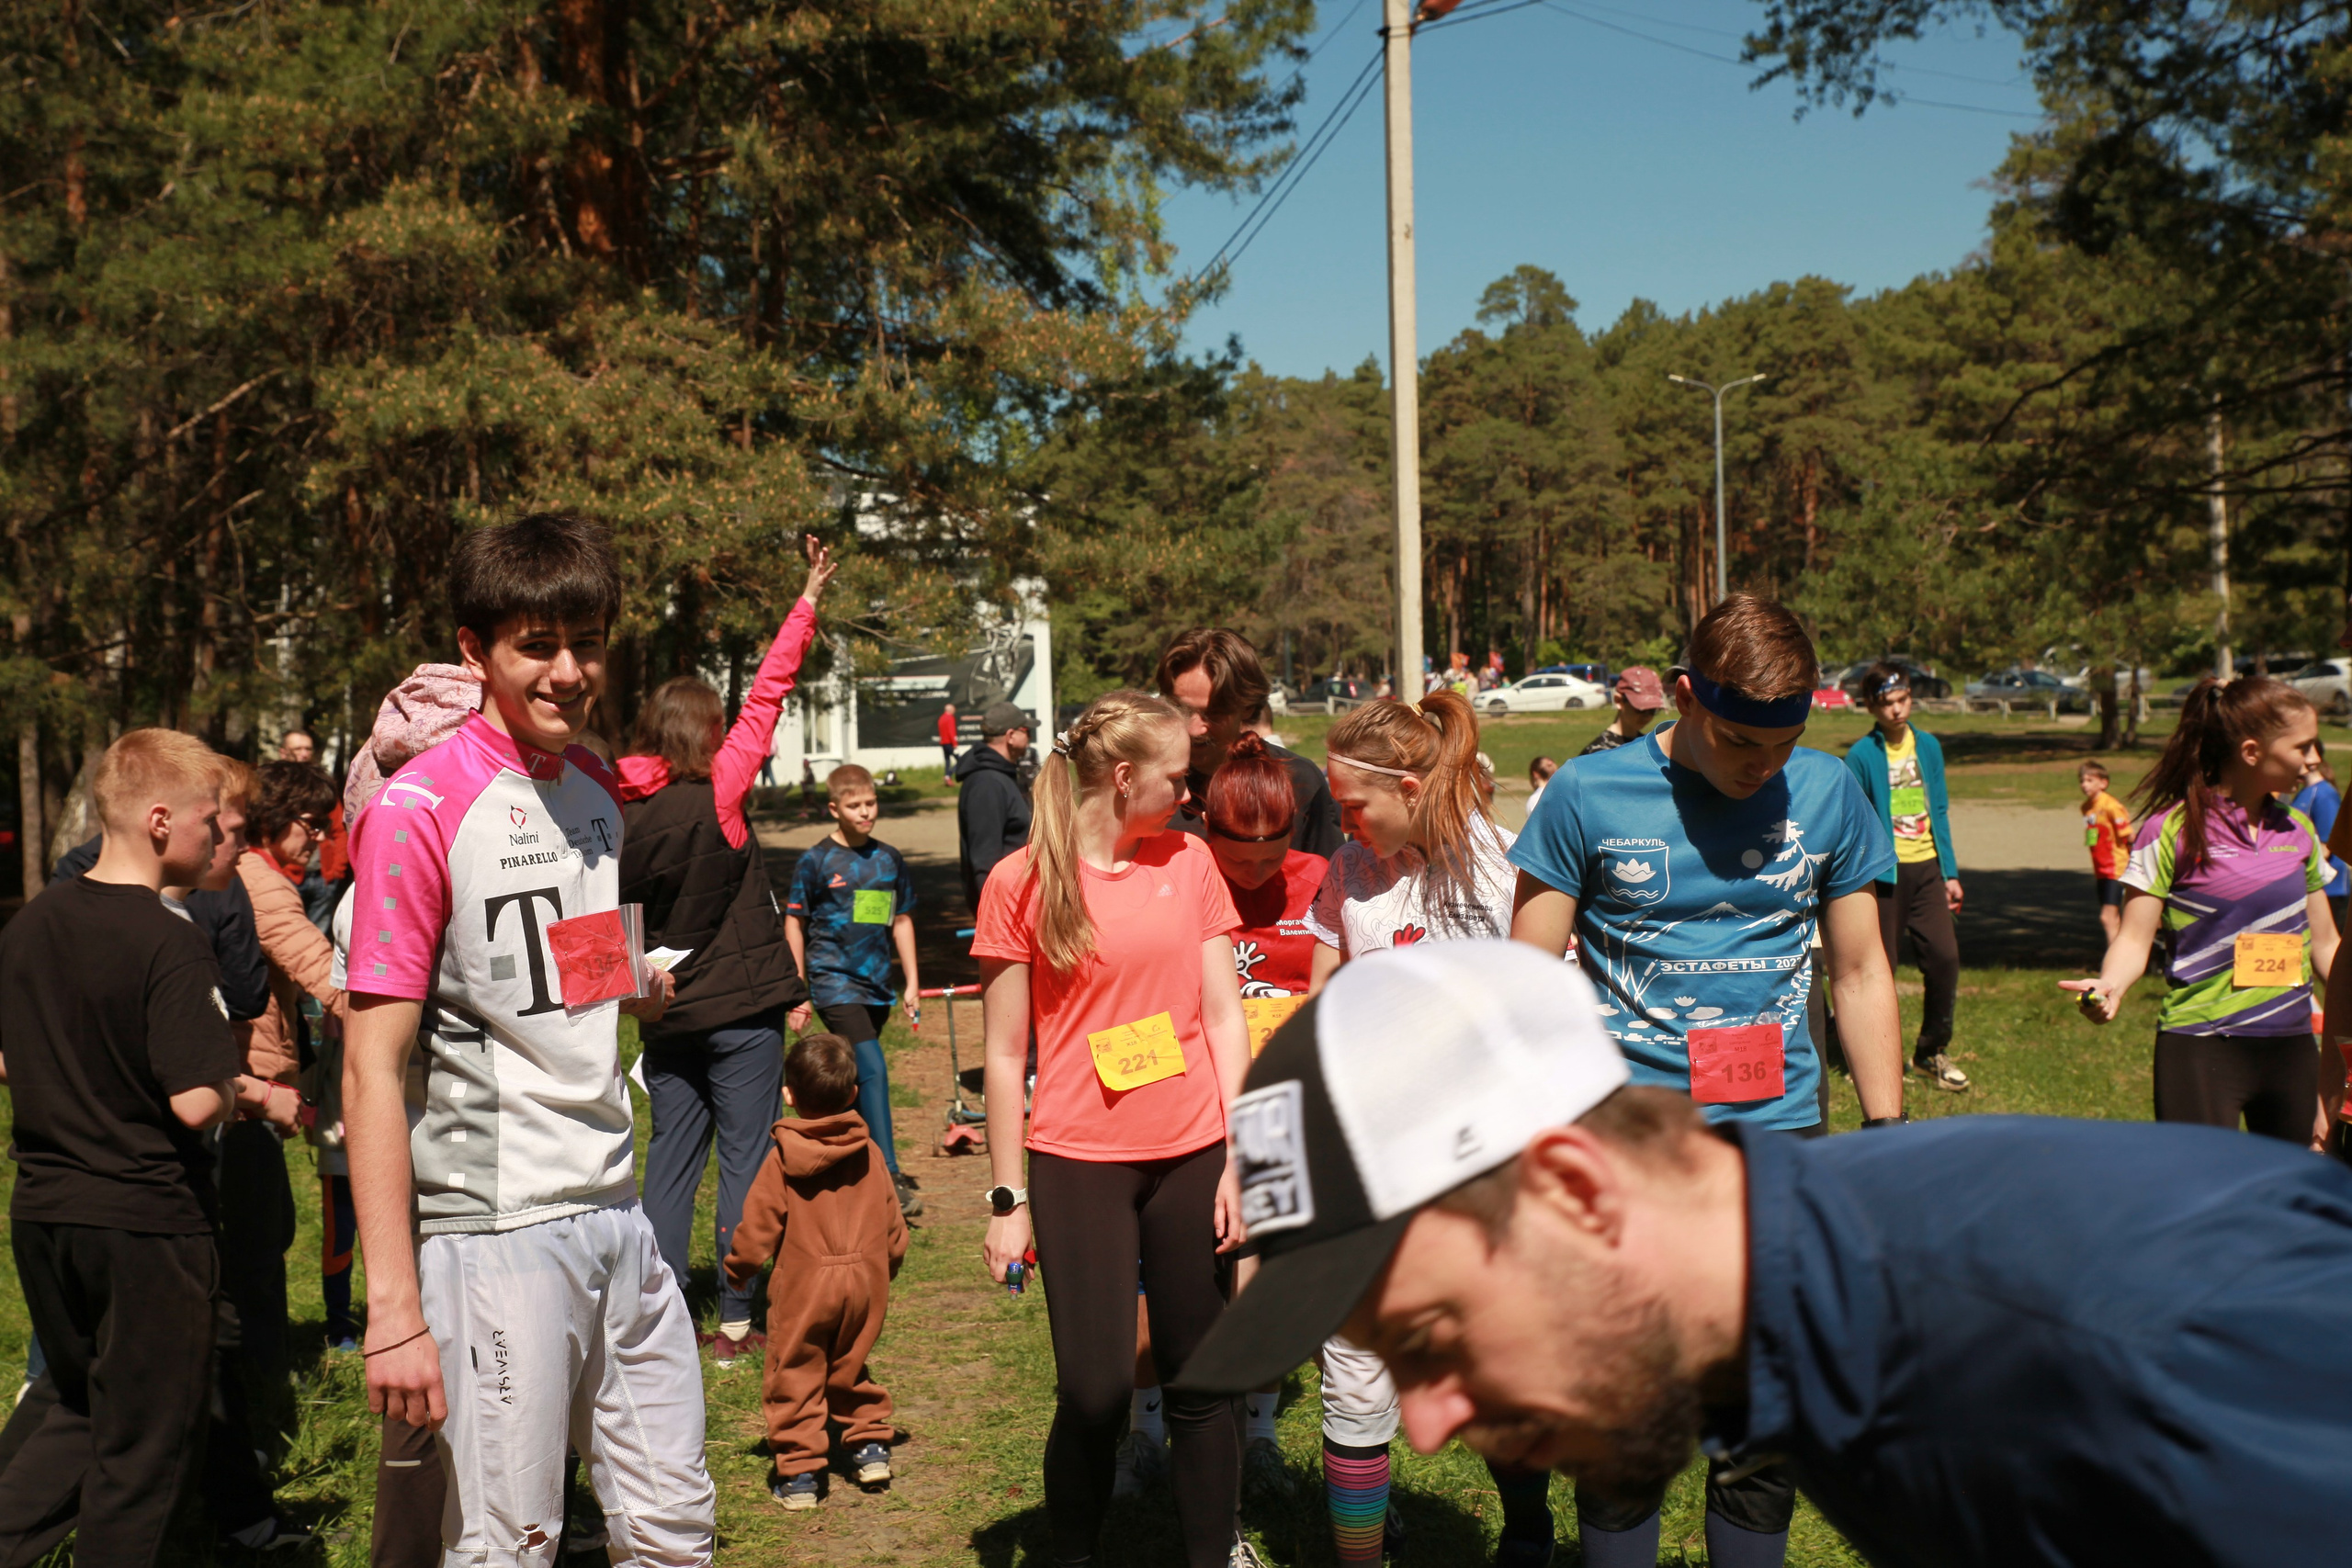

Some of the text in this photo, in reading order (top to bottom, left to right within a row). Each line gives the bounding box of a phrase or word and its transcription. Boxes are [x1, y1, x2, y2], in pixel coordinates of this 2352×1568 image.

[509, 830, 540, 847] Nalini
[565, 827, 581, 837] Team
[1601, 838, 1667, 847] ЧЕБАРКУЛЬ
[499, 851, 559, 870] PINARELLO
[1443, 899, 1494, 912] Кузнеченкова
[1660, 960, 1767, 972] ЭСТАФЕТЫ
[2254, 958, 2286, 972] 224
[1117, 1048, 1159, 1077] 221
[1721, 1060, 1767, 1084] 136
